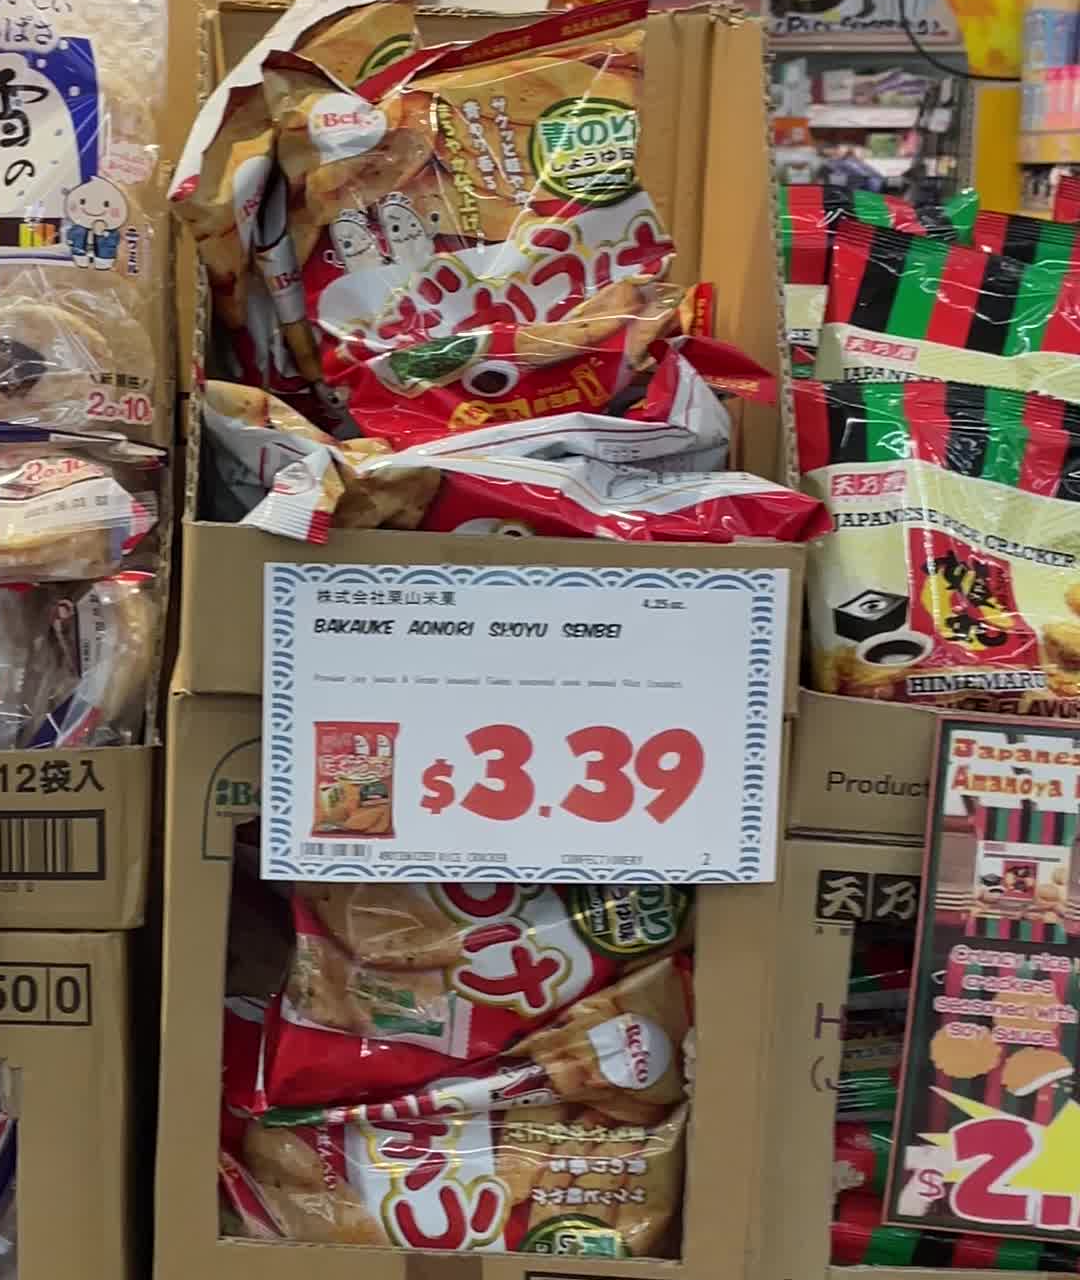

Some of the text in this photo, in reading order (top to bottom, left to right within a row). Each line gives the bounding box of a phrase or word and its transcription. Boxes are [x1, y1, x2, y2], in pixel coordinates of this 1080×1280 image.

[313, 619, 623, 639] BAKAUKE AONORI SHOYU SENBEI
[418, 723, 706, 825] $3.39
[55, 975, 82, 1014] 0
